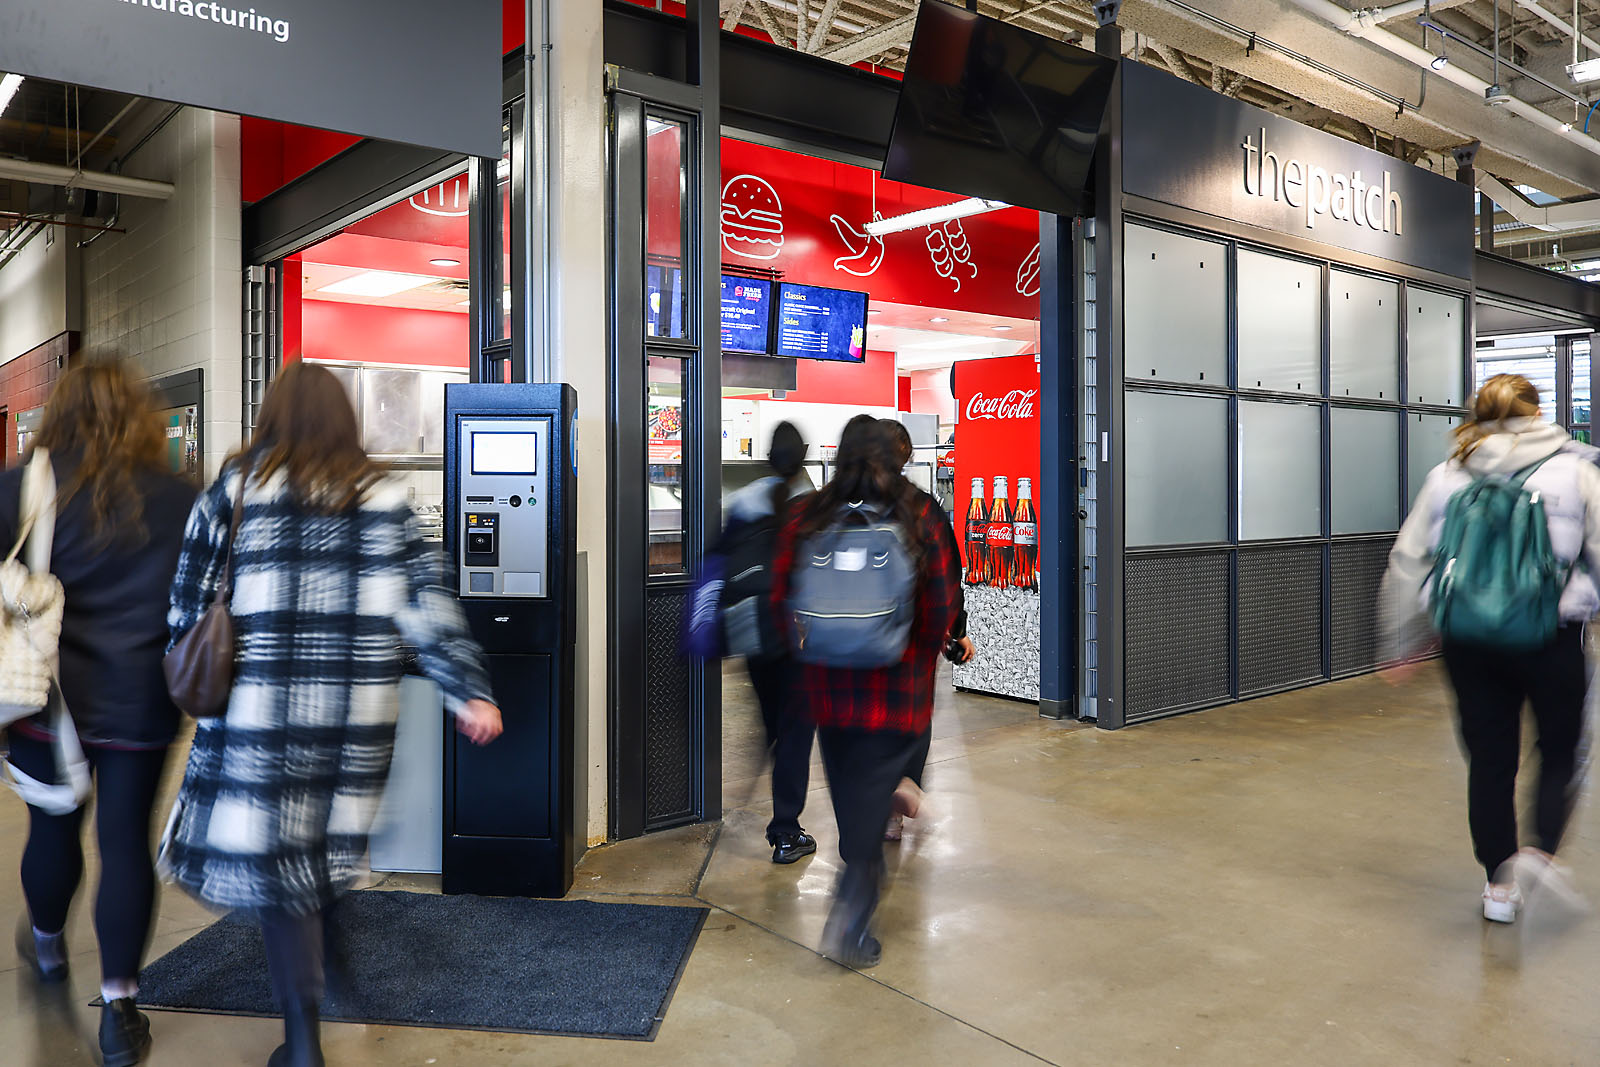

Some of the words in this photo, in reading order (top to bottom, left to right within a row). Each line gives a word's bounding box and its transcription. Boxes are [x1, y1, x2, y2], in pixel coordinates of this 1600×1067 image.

[118, 0, 289, 42] ufacturing
[784, 291, 806, 300] Classics
[783, 317, 799, 326] Sides
[966, 389, 1038, 420] Coca-Cola
[1014, 526, 1034, 536] Coke
